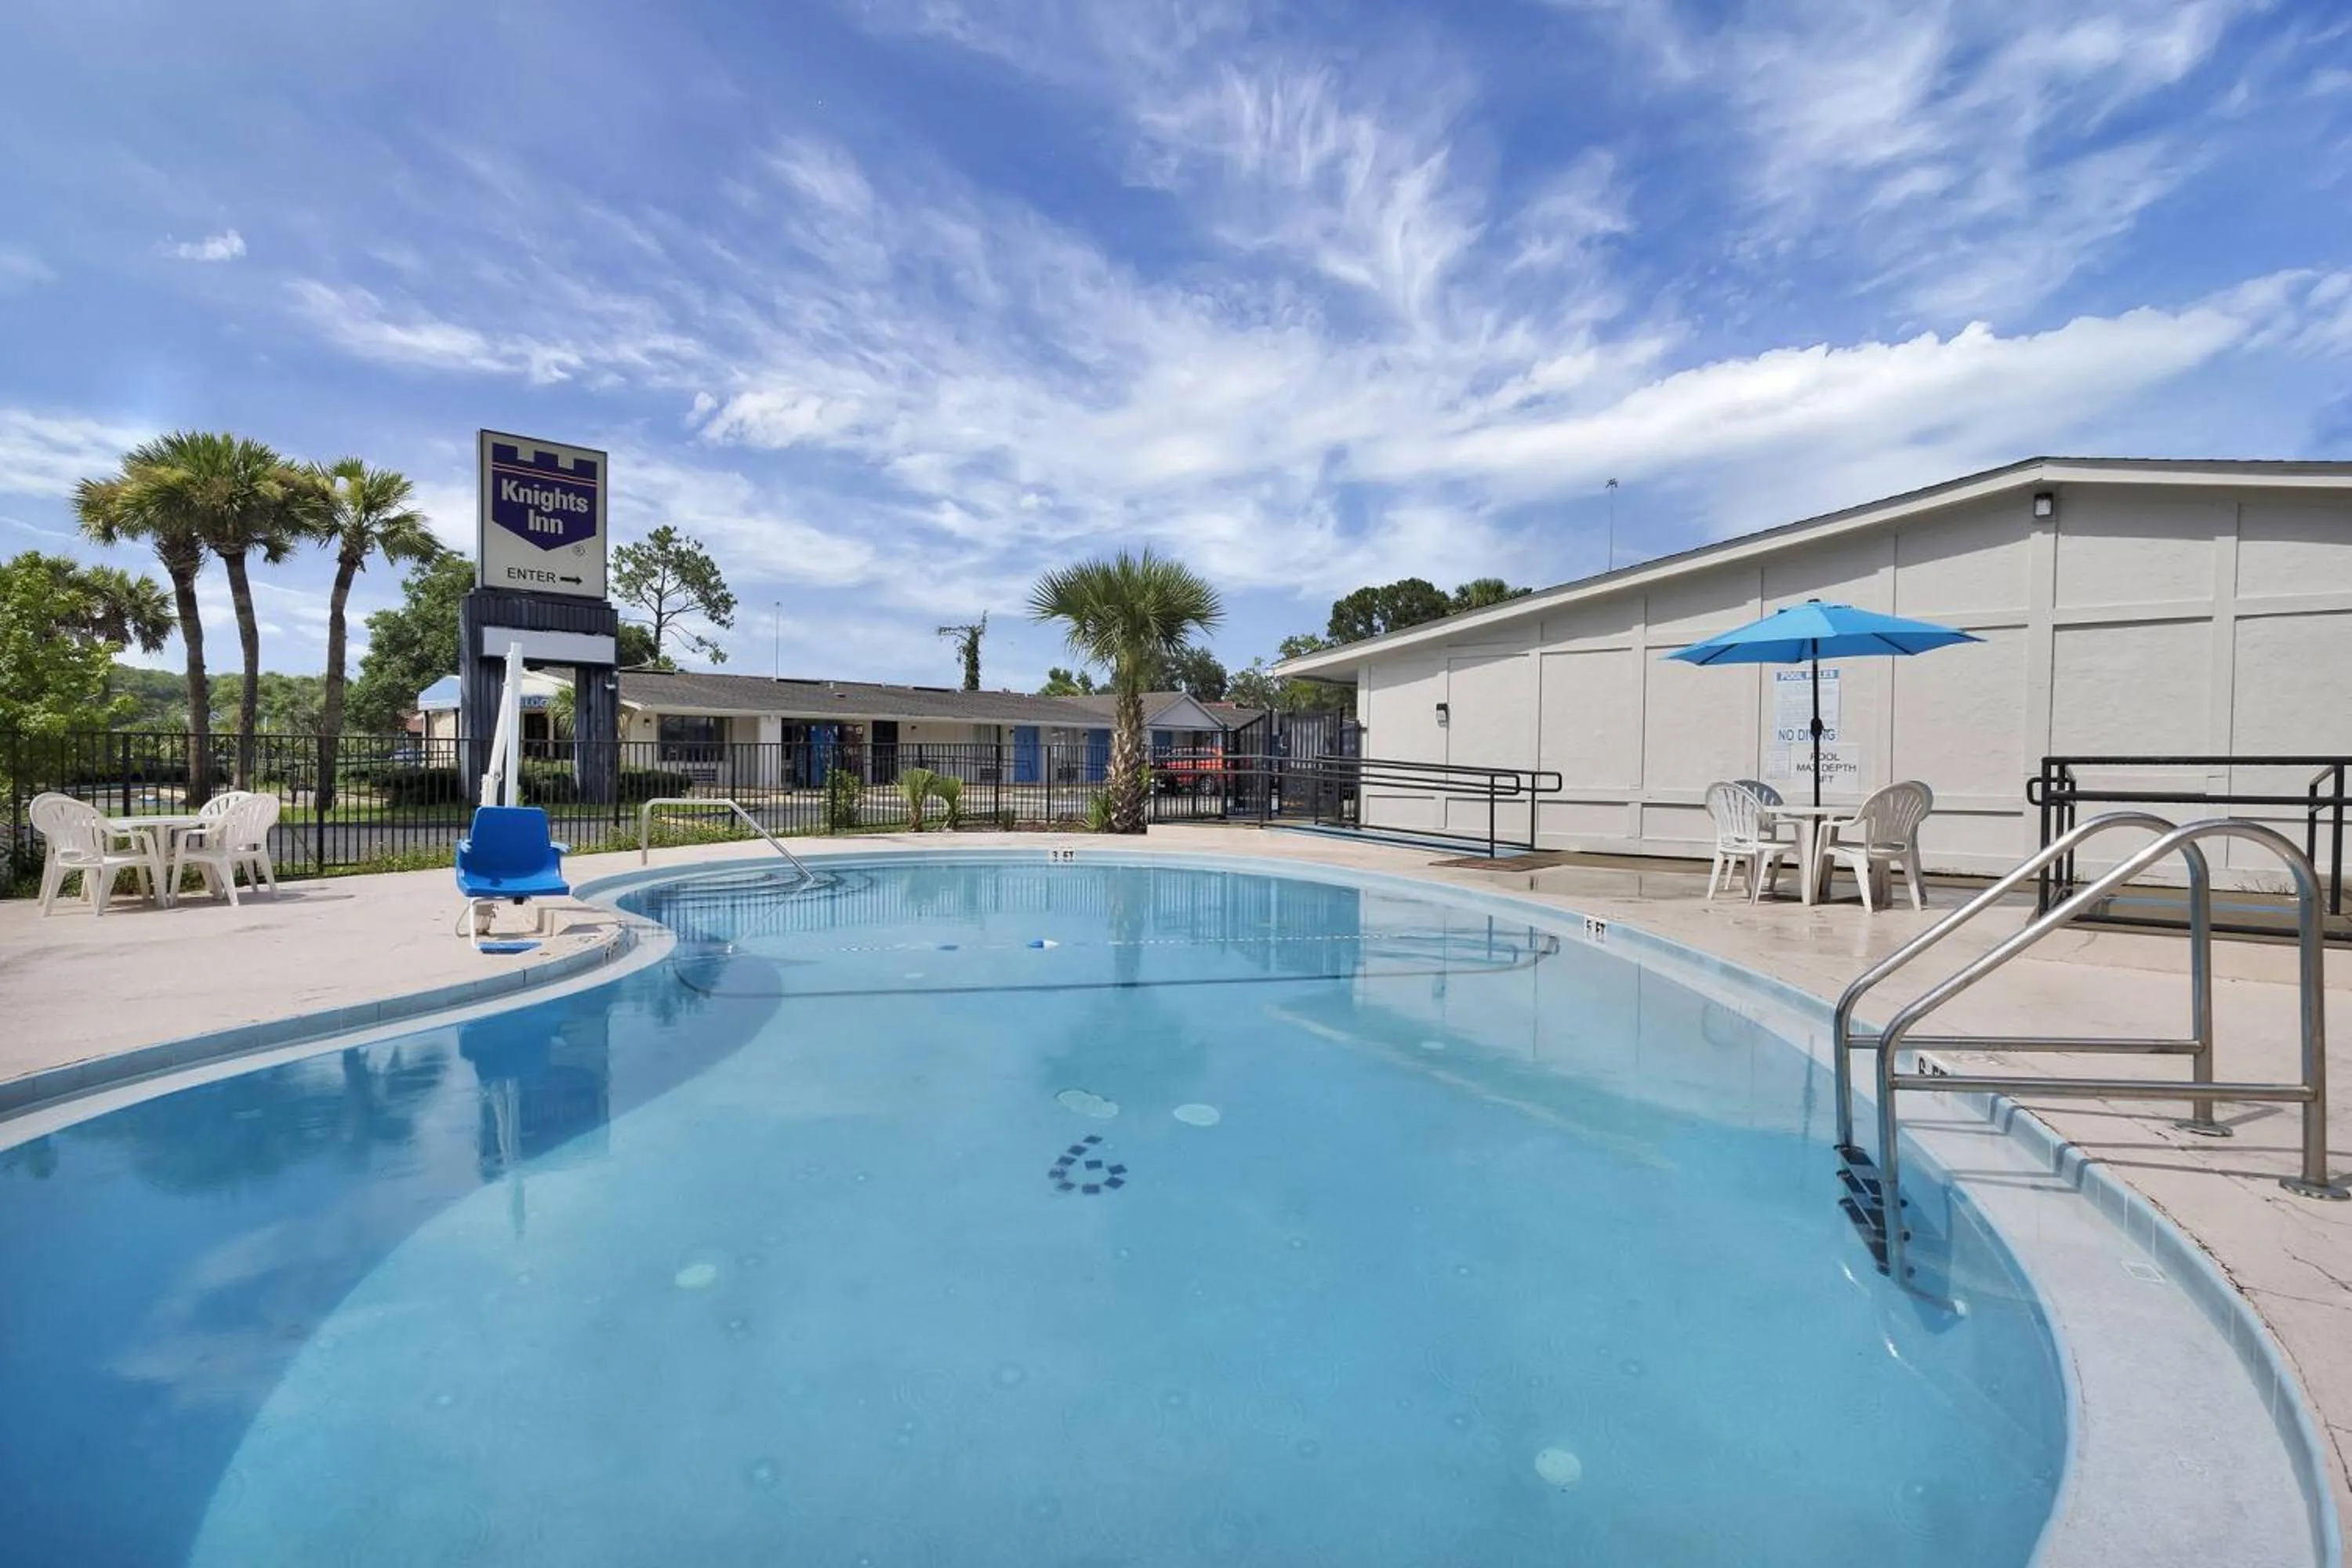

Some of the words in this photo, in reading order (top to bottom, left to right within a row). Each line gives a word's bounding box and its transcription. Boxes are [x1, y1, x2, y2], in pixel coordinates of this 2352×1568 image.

[502, 477, 589, 514] Knights
[528, 509, 564, 535] Inn
[506, 566, 557, 583] ENTER
[1778, 728, 1795, 741] NO
[1821, 763, 1857, 772] DEPTH
[1047, 1134, 1129, 1196] 6
